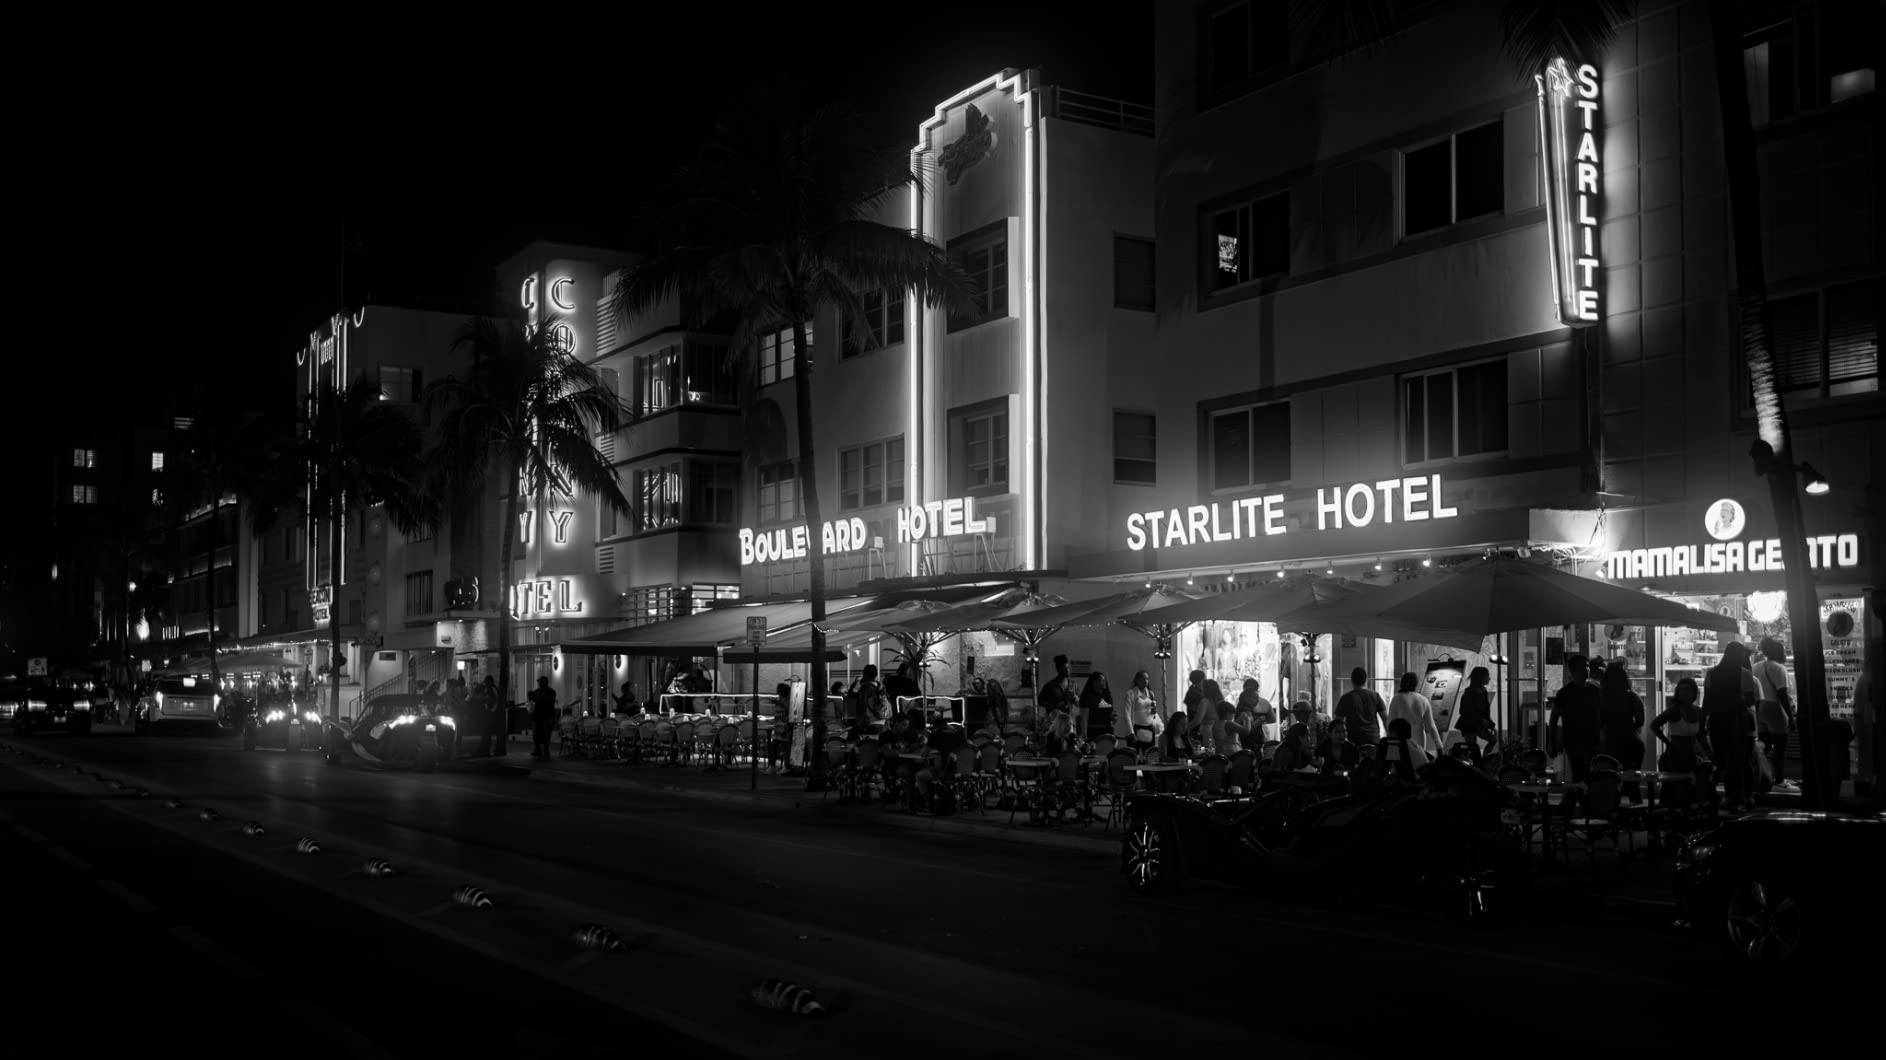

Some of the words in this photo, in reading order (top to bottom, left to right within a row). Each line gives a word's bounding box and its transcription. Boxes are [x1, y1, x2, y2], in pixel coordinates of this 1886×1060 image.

[1577, 64, 1599, 320] STARLITE
[739, 516, 867, 565] BOULEARD
[898, 496, 987, 543] HOTEL
[1127, 493, 1287, 551] STARLITE
[1317, 473, 1458, 530] HOTEL
[1608, 541, 1744, 579] MAMALISA
